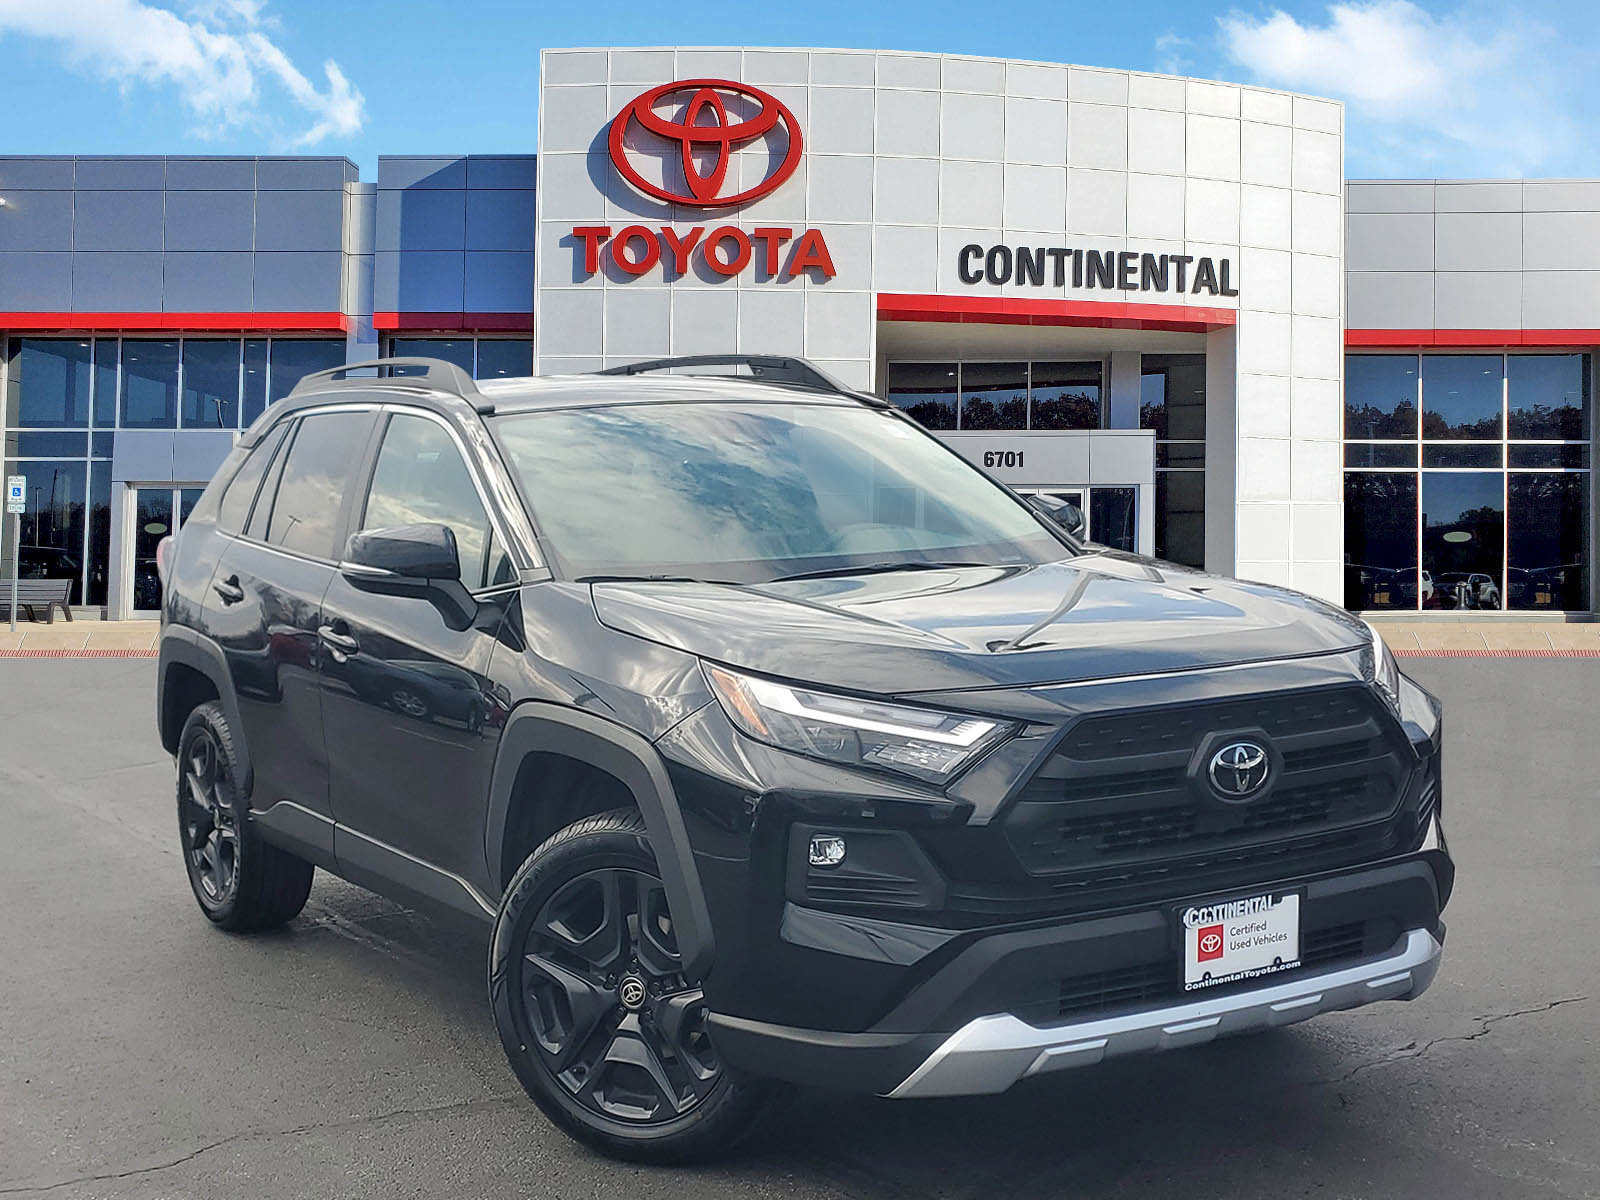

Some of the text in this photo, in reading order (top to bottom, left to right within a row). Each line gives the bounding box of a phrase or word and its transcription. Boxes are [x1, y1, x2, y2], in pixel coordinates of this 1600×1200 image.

[573, 225, 837, 276] TOYOTA
[958, 244, 1239, 296] CONTINENTAL
[983, 451, 1024, 468] 6701
[1184, 894, 1274, 928] CONTINENTAL
[1229, 920, 1267, 937] Certified
[1229, 932, 1288, 951] Used Vehicles
[1184, 960, 1301, 991] ContinentalToyota.com
